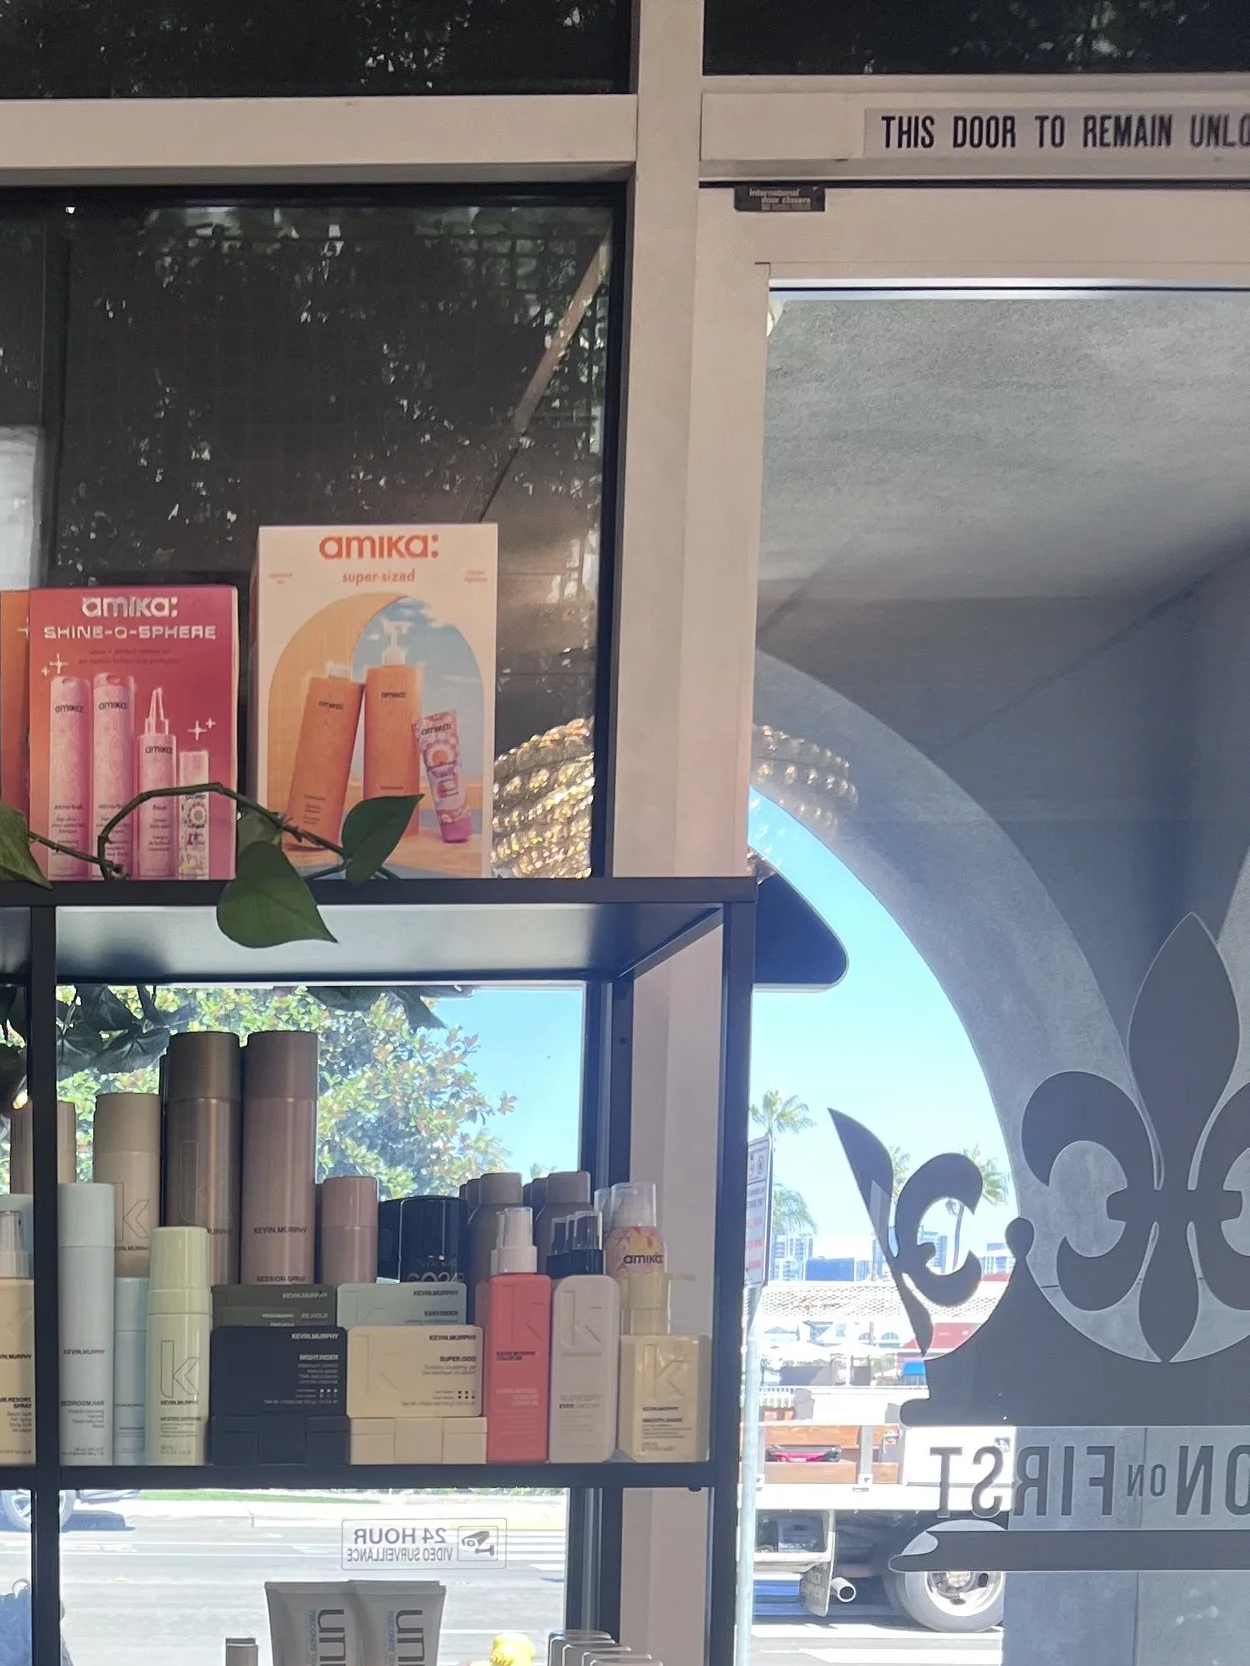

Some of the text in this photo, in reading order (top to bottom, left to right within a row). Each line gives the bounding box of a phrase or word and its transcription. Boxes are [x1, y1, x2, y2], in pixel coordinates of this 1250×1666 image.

[882, 116, 935, 148] THIS
[952, 116, 1016, 148] DOOR
[1035, 116, 1065, 148] TO
[1082, 115, 1173, 148] REMAIN
[319, 535, 439, 559] amika:
[342, 568, 415, 583] super-sized
[82, 596, 178, 618] amika:
[44, 625, 216, 639] SHINE-O-SPHERE
